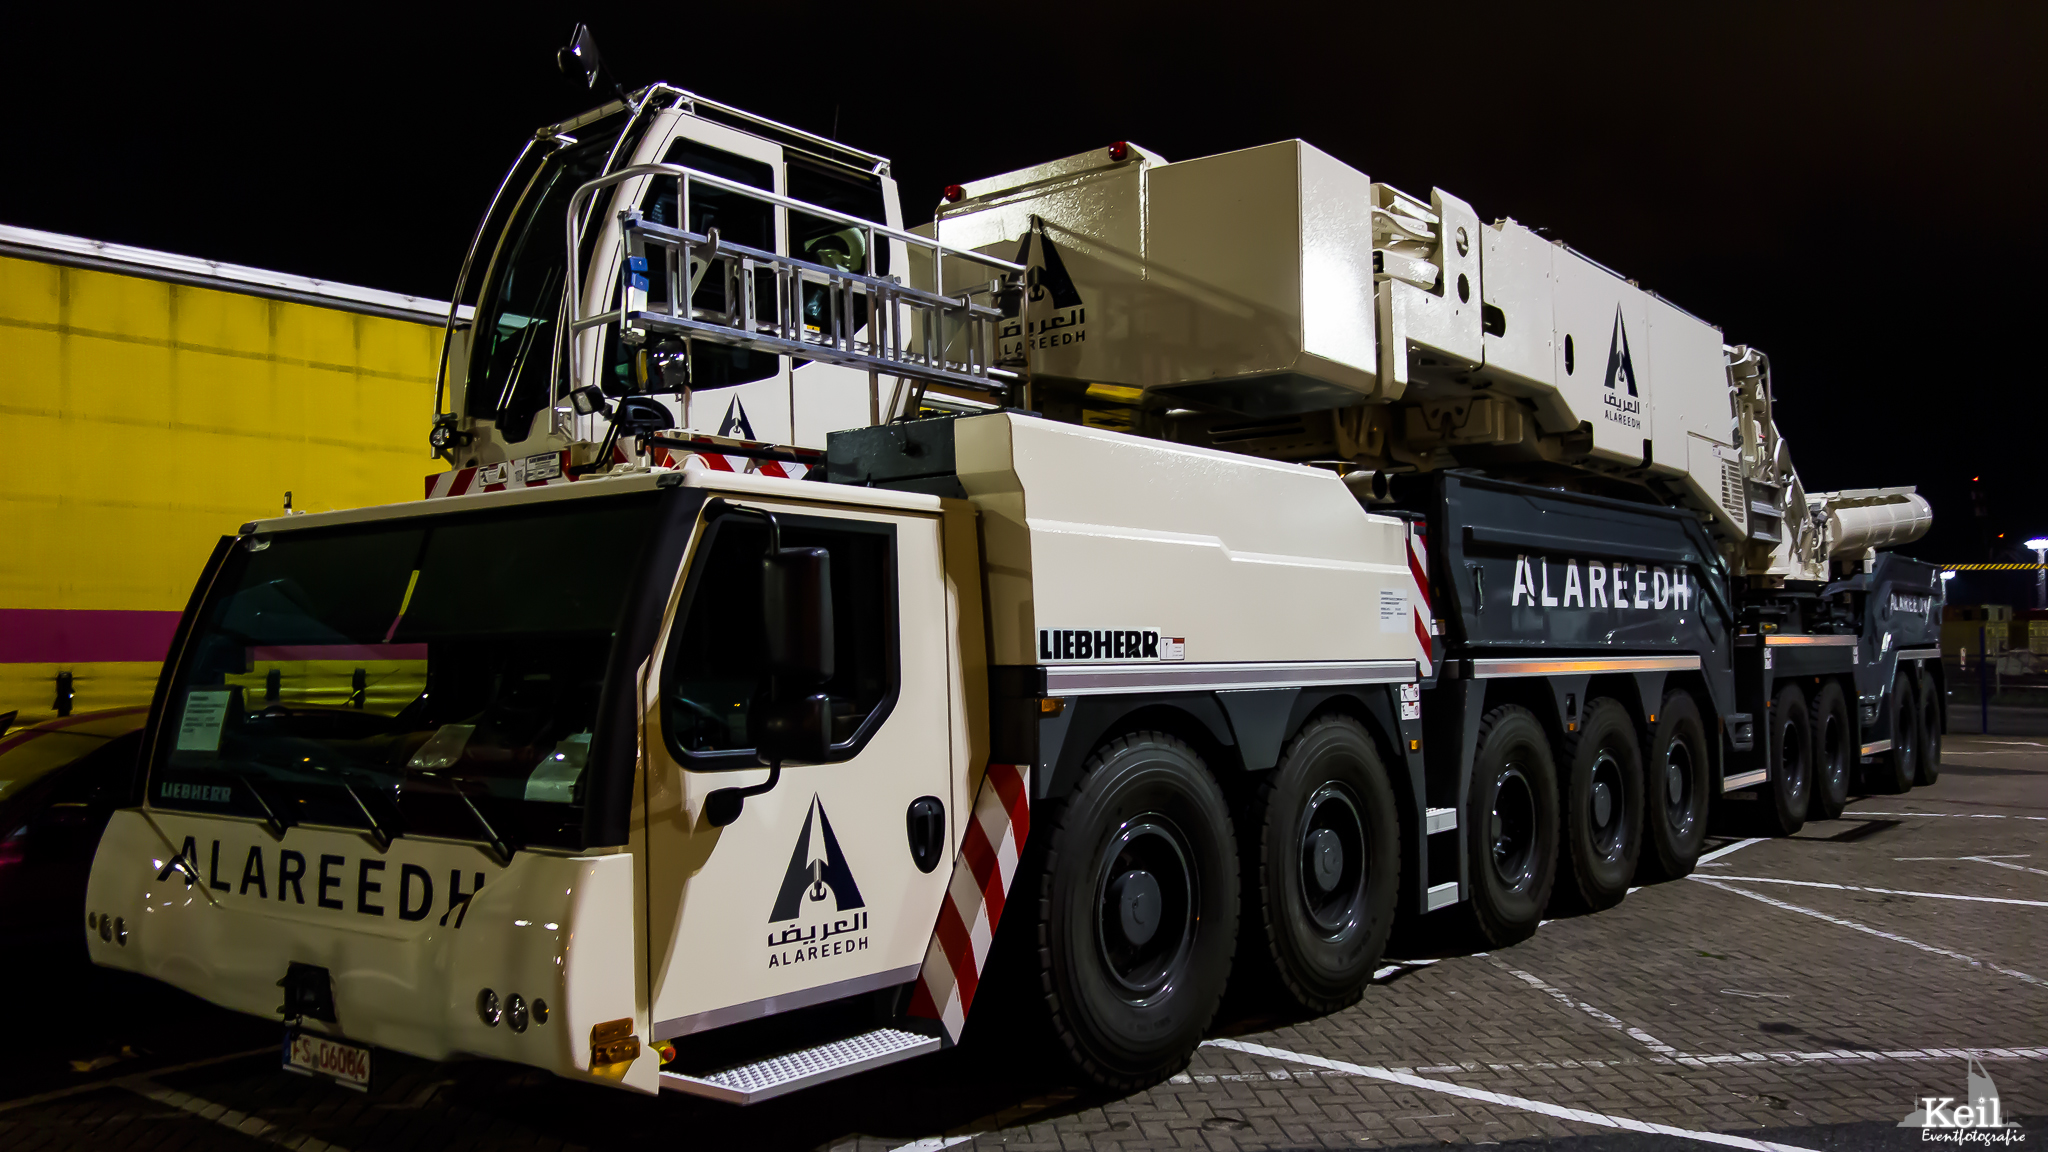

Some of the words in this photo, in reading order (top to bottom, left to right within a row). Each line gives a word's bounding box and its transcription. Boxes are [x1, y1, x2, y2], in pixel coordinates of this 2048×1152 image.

[999, 330, 1085, 357] LAREEDH
[1604, 392, 1640, 415] العريض
[1604, 409, 1641, 430] ALAREEDH
[1511, 553, 1688, 611] ALAREEDH
[1039, 630, 1159, 660] LIEBHERR
[160, 781, 232, 803] LIEBHERR
[156, 835, 486, 929] ALAREEDH
[767, 911, 868, 947] العريض
[768, 936, 869, 969] ALAREEDH
